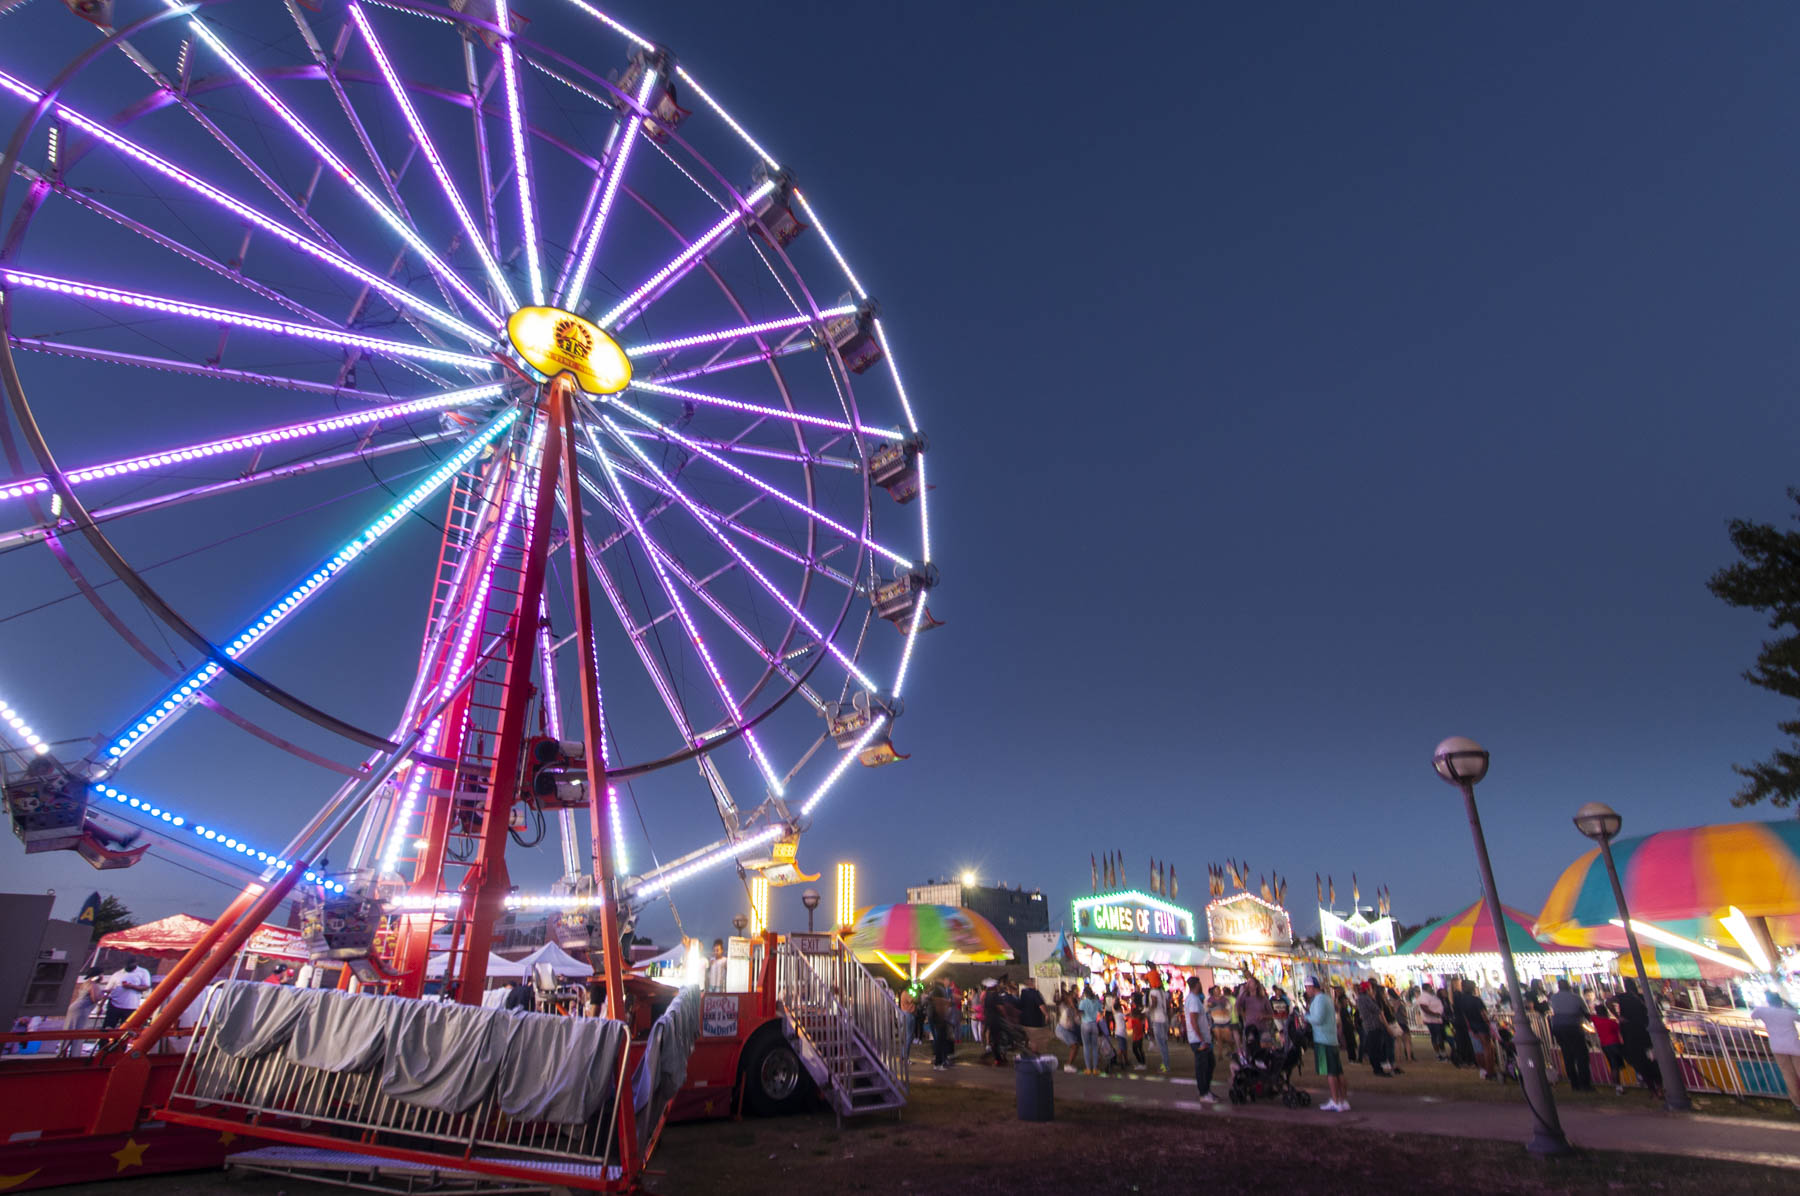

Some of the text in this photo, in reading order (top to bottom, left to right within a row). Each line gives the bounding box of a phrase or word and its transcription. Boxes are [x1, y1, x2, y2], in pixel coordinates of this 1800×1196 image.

[1093, 904, 1176, 935] GAMES OF FUN
[802, 938, 819, 952] EXIT
